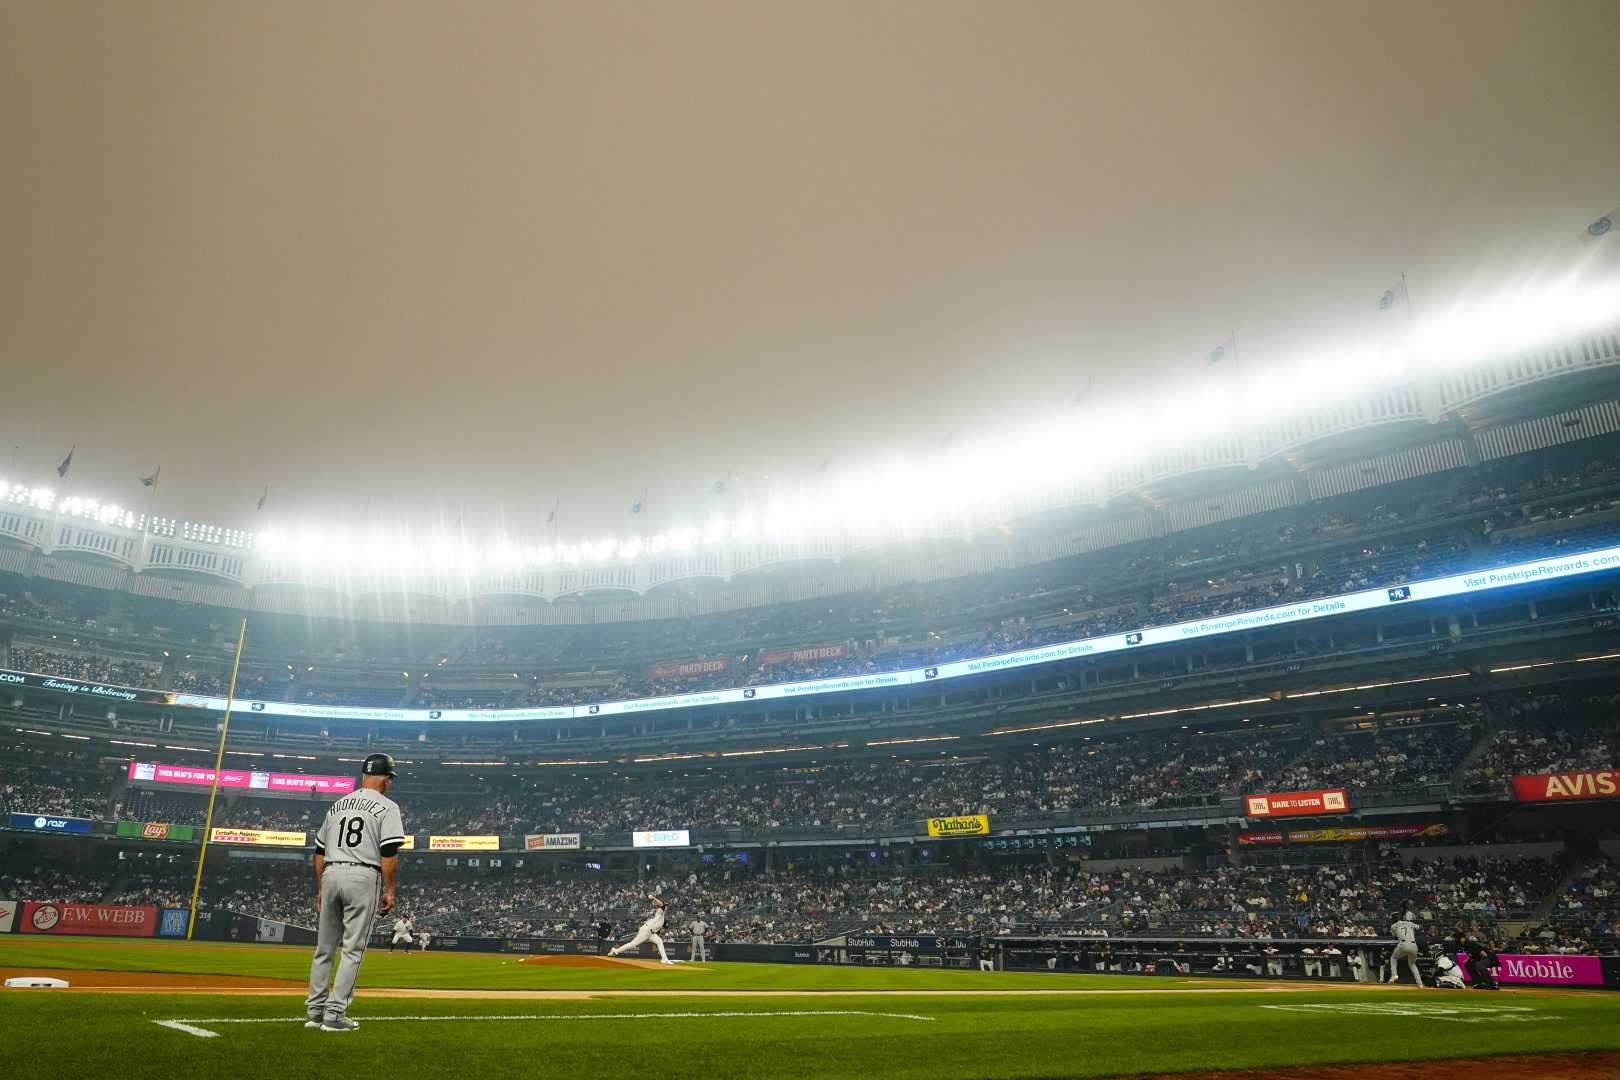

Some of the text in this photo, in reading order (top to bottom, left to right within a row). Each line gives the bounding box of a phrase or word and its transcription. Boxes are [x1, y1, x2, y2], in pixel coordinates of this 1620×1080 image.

[1464, 555, 1619, 588] Visit PinstripeRewards.com
[1182, 601, 1345, 635] Visit PinstripeRewards.com for Details
[793, 646, 842, 661] PARTY DECK
[1069, 644, 1093, 654] Details
[703, 660, 724, 672] DECK
[42, 679, 79, 693] Tasting
[91, 686, 137, 700] Believing
[159, 769, 173, 777] THIS
[1545, 772, 1616, 797] AVIS
[330, 798, 386, 819] RODRIGUEZ
[1271, 800, 1290, 809] DARE
[1297, 798, 1321, 807] LISTEN
[47, 819, 67, 828] razr
[933, 817, 982, 833] Nathan's
[337, 816, 365, 848] 18
[546, 836, 577, 846] AMAZING
[62, 907, 91, 921] F.W.
[98, 908, 145, 923] WEBB
[848, 937, 919, 948] StubHub StubHub
[1506, 960, 1574, 979] Mobile
